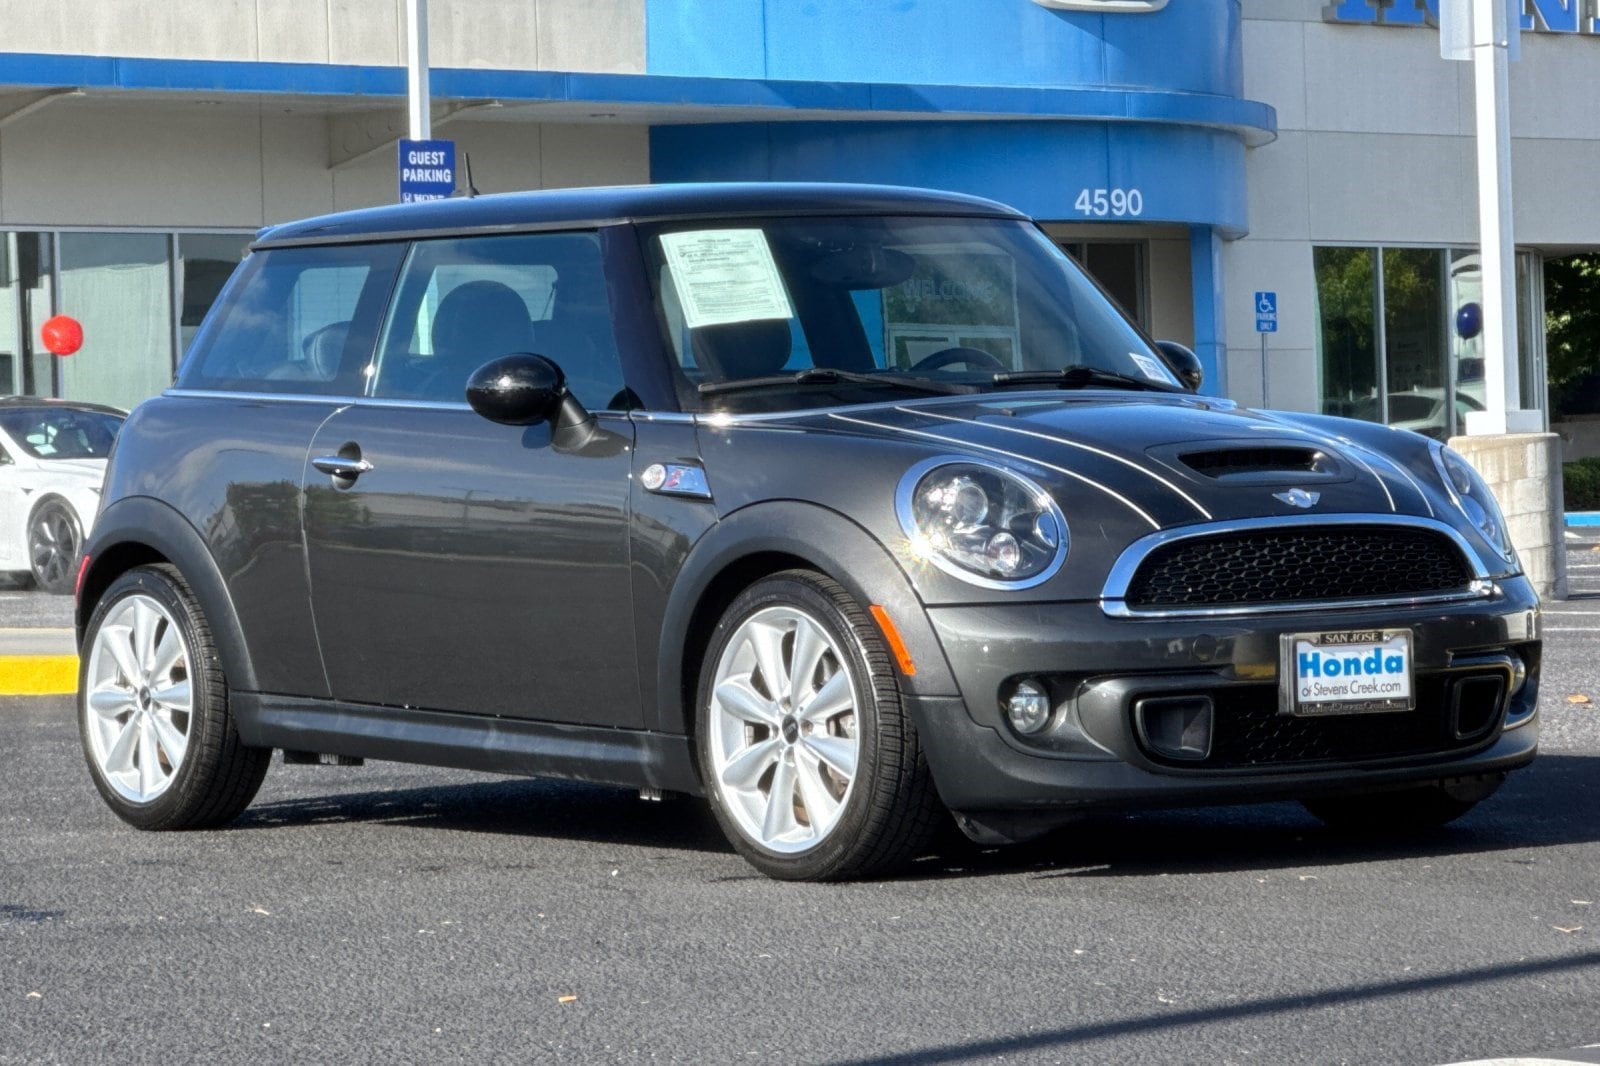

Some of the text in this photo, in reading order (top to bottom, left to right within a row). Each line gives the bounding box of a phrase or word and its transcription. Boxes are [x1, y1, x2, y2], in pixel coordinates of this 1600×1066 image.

[408, 150, 446, 166] GUEST
[402, 168, 452, 184] PARKING
[1074, 188, 1143, 216] 4590
[1325, 632, 1379, 643] SAN JOSE
[1299, 647, 1403, 678] Honda
[1302, 677, 1401, 697] of Stevens Creek.com
